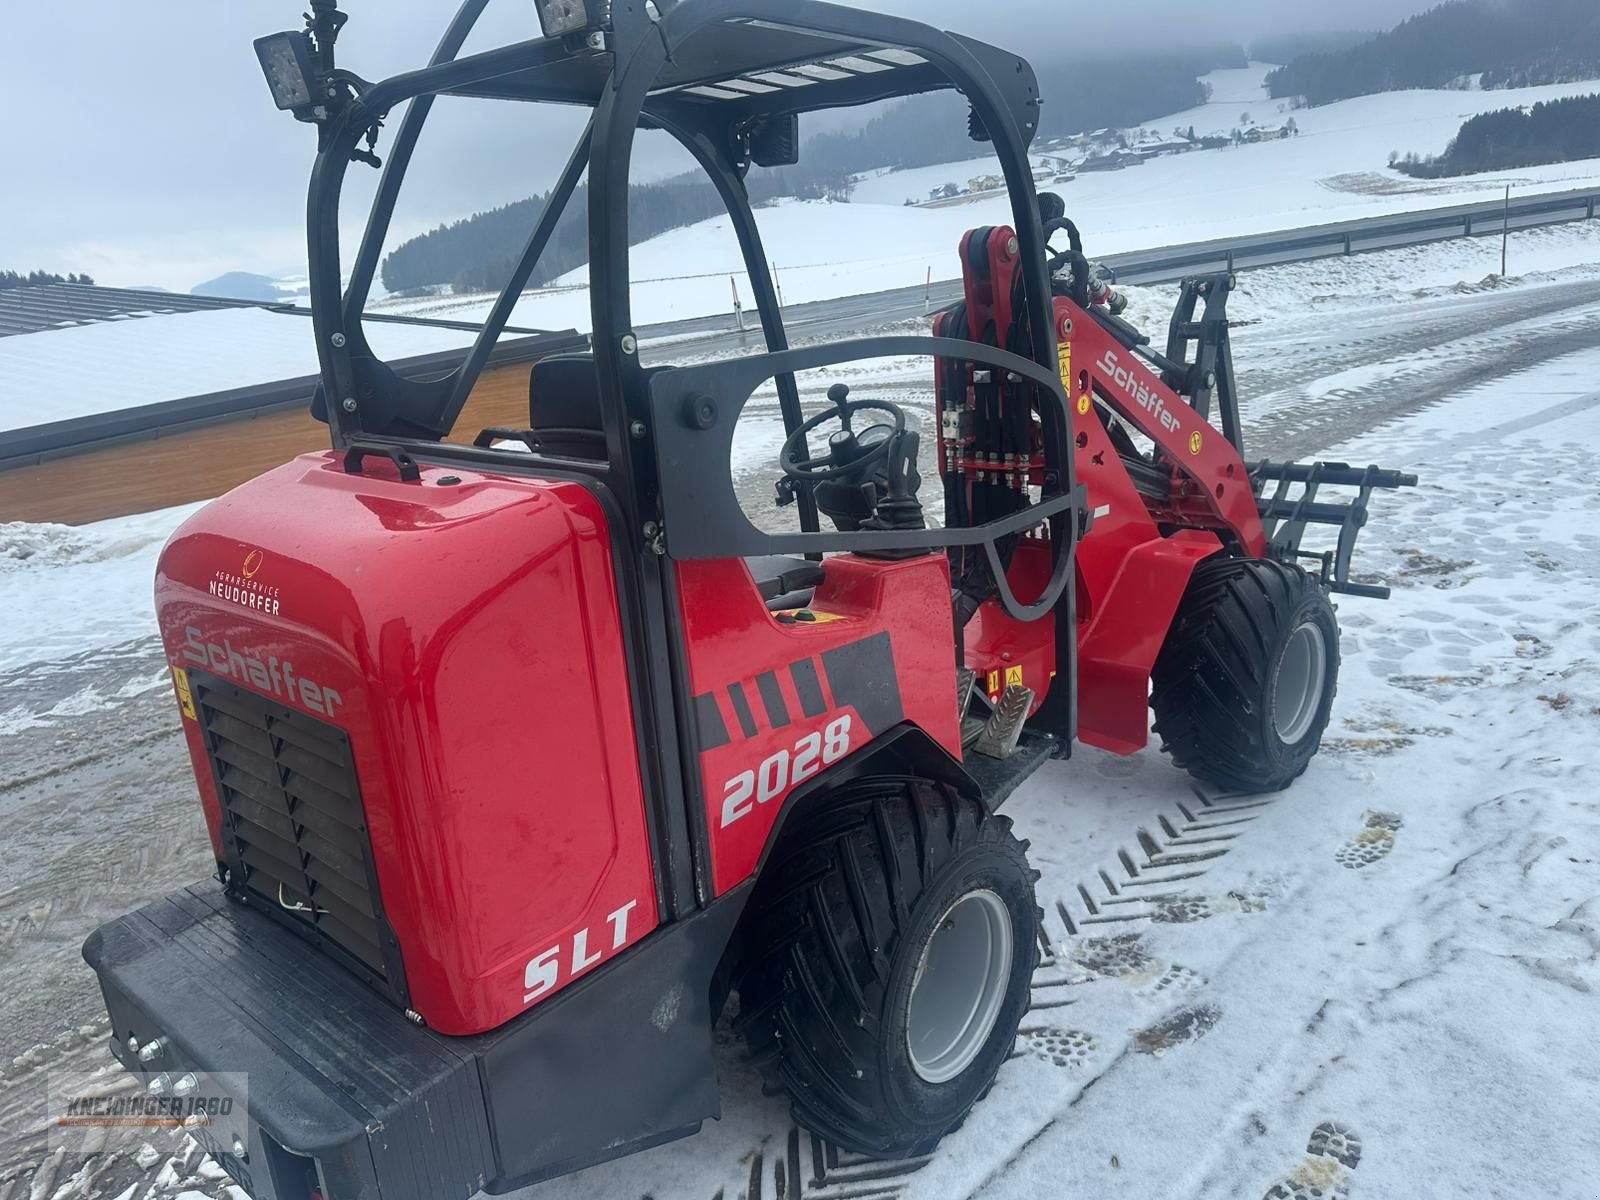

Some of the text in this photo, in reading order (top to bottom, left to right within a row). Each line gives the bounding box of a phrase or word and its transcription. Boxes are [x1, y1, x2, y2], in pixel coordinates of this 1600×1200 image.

[1096, 350, 1181, 433] Schäffer
[209, 580, 280, 616] NEUDORFER
[215, 570, 280, 598] AGRARSERVICE
[183, 625, 343, 718] Schäffer
[720, 714, 852, 829] 2028
[523, 899, 637, 1004] SLT
